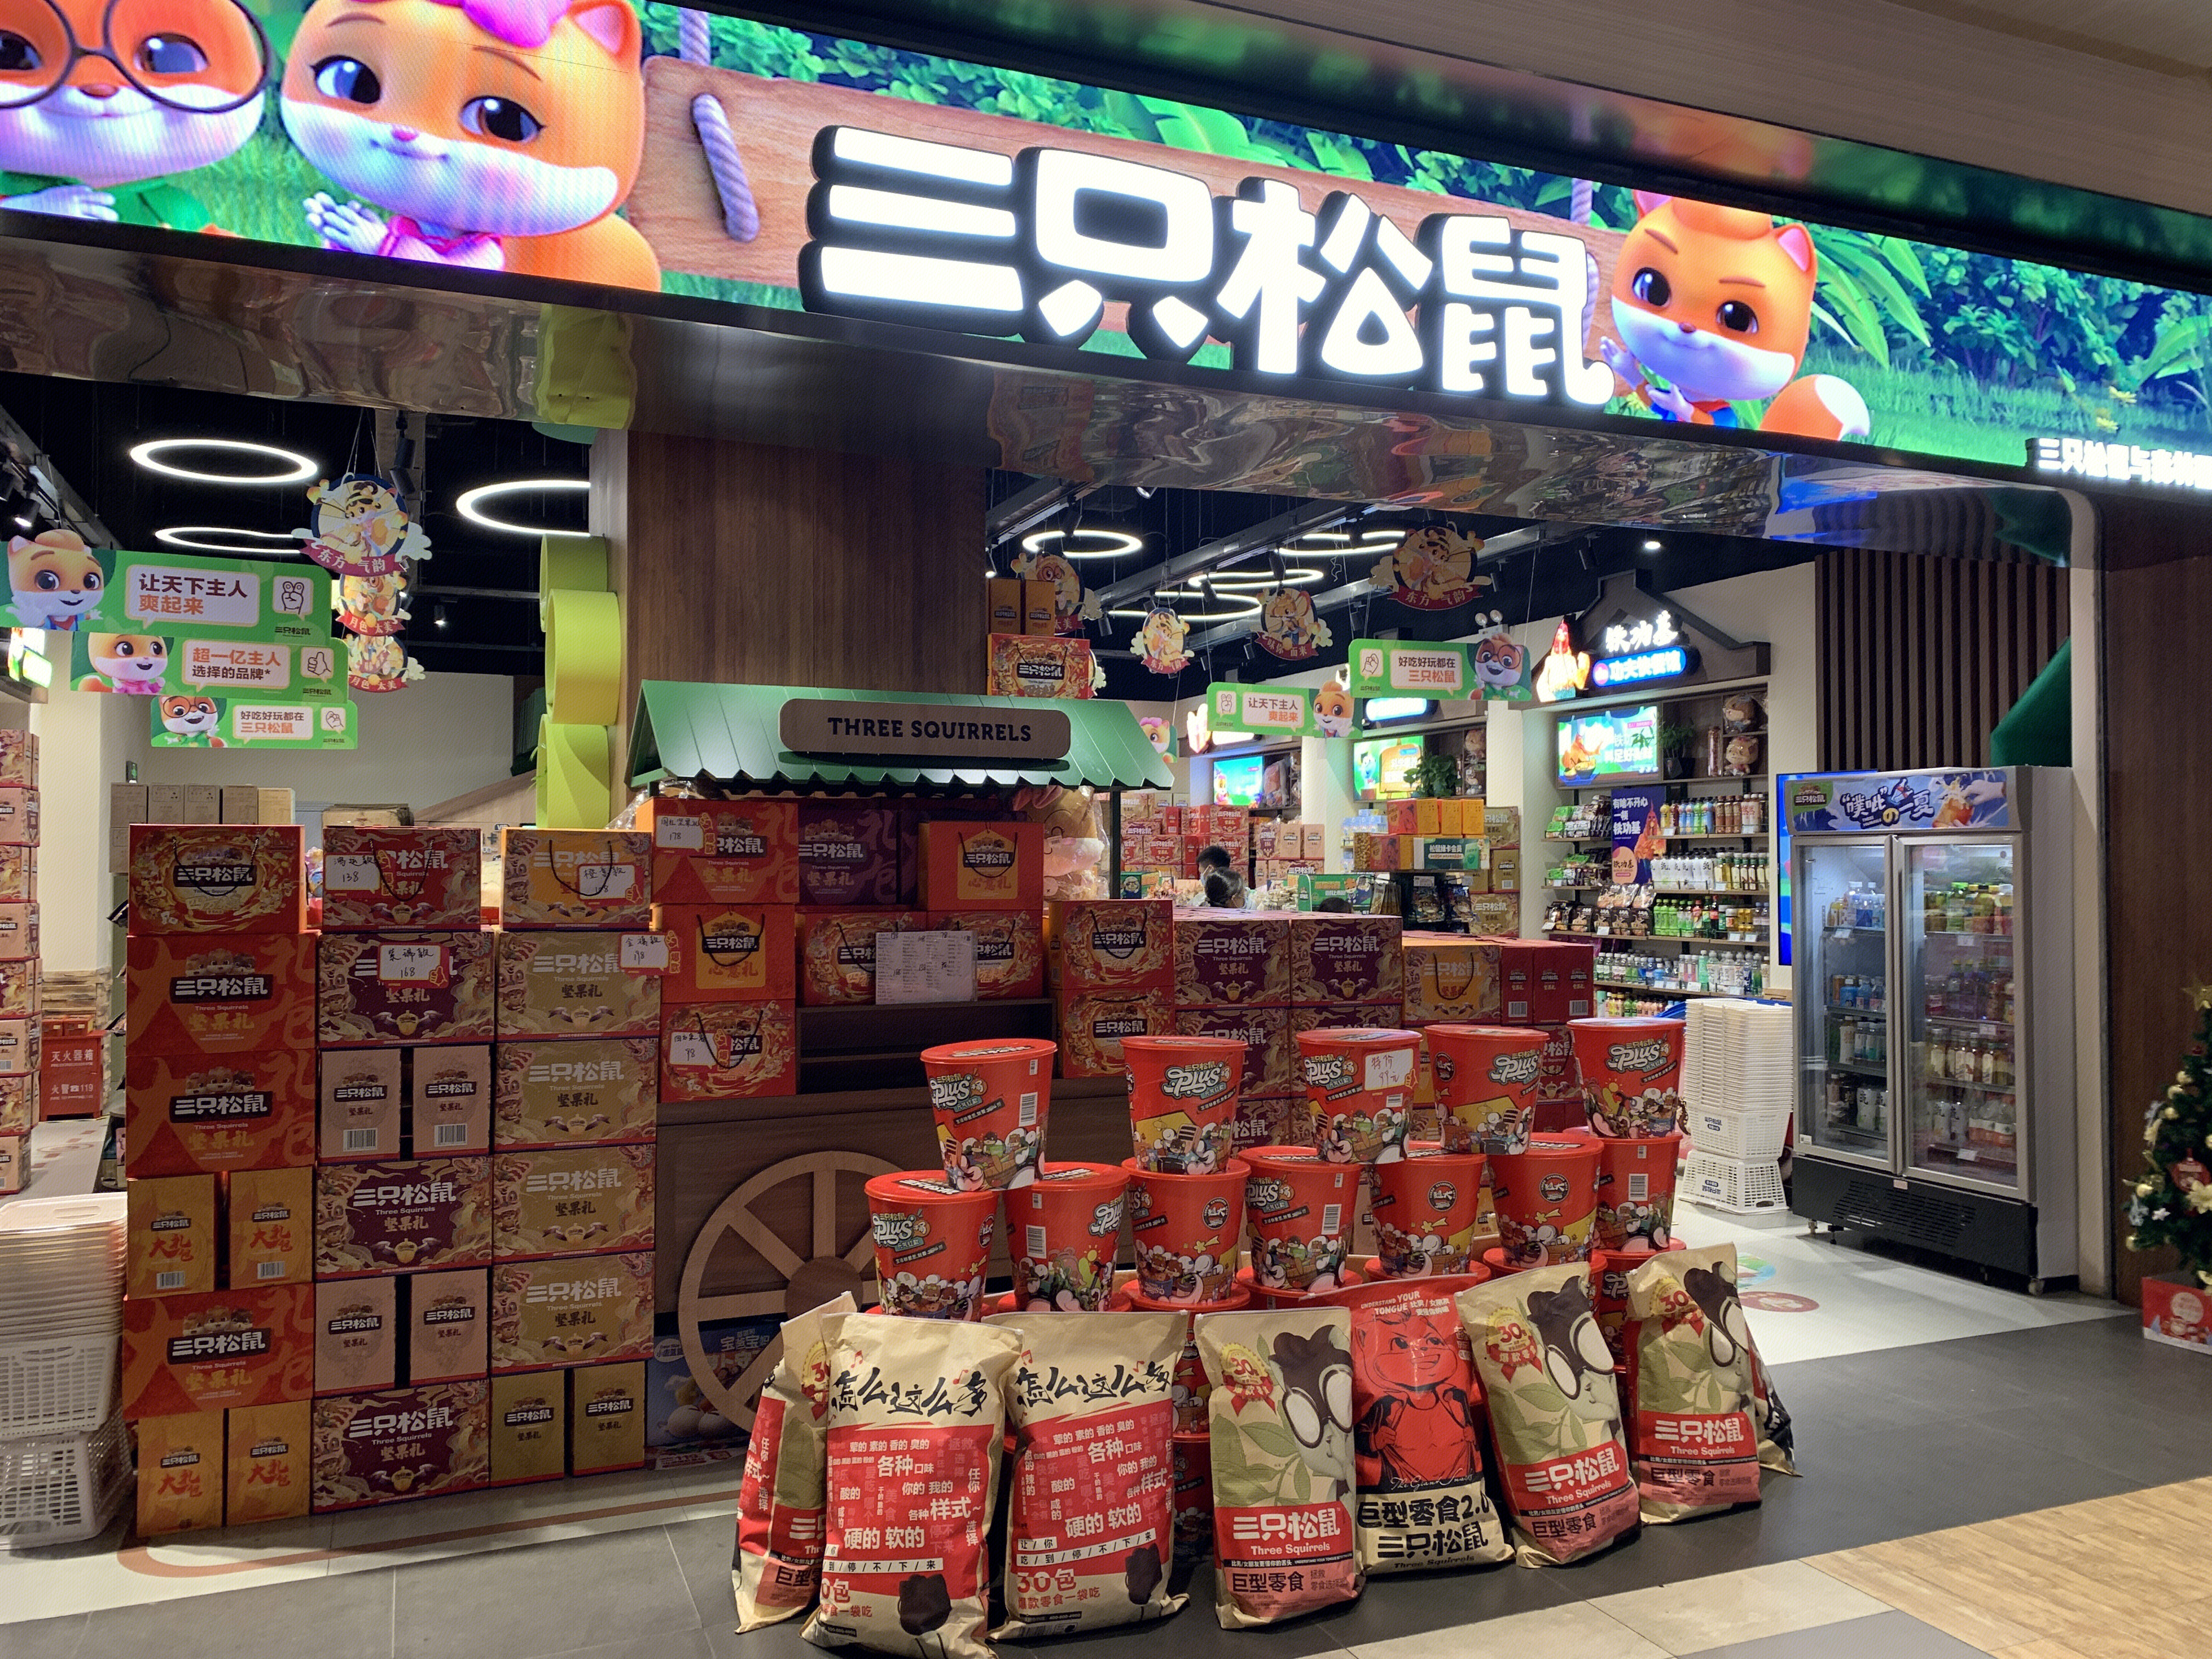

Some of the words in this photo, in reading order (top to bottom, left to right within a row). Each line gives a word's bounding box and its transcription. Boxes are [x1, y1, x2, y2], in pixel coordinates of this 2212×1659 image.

[820, 123, 1616, 405] 三只松鼠
[317, 549, 346, 569] 东方
[139, 573, 248, 599] 让天下主人
[139, 594, 204, 616] 爽起来
[1405, 591, 1431, 607] 东方
[374, 620, 394, 633] 太美
[193, 647, 281, 667] 超一亿主人
[1398, 656, 1456, 669] 好吃好玩都在
[1408, 669, 1457, 684] 三只松鼠
[1248, 697, 1299, 711] 让天下主人
[240, 710, 305, 722] 好吃好玩都在
[1268, 711, 1299, 723] 爽起来
[240, 721, 295, 735] 三只松鼠
[827, 716, 904, 738] THREE
[910, 719, 1032, 742] SQUIRRELS
[1613, 797, 1649, 809] 有啥不开心
[669, 832, 681, 840] 178
[1613, 822, 1641, 836] 铁功基
[798, 843, 864, 859] 三只松鼠
[964, 852, 1011, 865] 三只松鼠
[177, 866, 253, 883] 三只松鼠
[342, 871, 359, 883] 138
[704, 935, 757, 950] 三只松鼠
[1198, 936, 1267, 955] 三只松鼠
[1314, 935, 1380, 953] 三只松鼠
[634, 950, 645, 966] 198
[400, 967, 416, 979] 168
[174, 976, 269, 997] 三只松鼠
[561, 984, 603, 999] 坚果礼
[1095, 1020, 1145, 1034] 三只松鼠
[50, 1048, 94, 1062] 灭火器箱
[685, 1048, 696, 1062] 98
[1372, 1054, 1394, 1070] 特价
[528, 1060, 625, 1083] 三只松鼠
[80, 1083, 94, 1093] 119
[336, 1087, 385, 1099] 三只松鼠
[427, 1082, 474, 1095] 三只松鼠
[173, 1093, 268, 1115] 三只松鼠
[557, 1092, 599, 1108] 坚果礼
[526, 1167, 622, 1193] 三只松鼠
[353, 1181, 457, 1207] 三只松鼠
[253, 1210, 290, 1221] 三只松鼠
[400, 1206, 436, 1215] Squirrels
[555, 1200, 597, 1217] 坚果礼
[152, 1218, 190, 1229] 三只松鼠
[526, 1277, 622, 1304] 三只松鼠
[546, 1304, 568, 1312] Three
[569, 1300, 603, 1310] Squirrels
[1361, 1299, 1396, 1310] UNDERSTAND
[1397, 1291, 1421, 1303] YOUR
[1660, 1290, 1689, 1313] 30
[426, 1308, 473, 1322] 三只松鼠
[1374, 1303, 1408, 1316] TONGUE
[330, 1317, 380, 1331] 三只松鼠
[555, 1311, 597, 1328] 坚果礼
[172, 1331, 266, 1357] 三只松鼠
[832, 1367, 989, 1417] 怎么这么多
[1014, 1361, 1172, 1408] 怎么这么多
[587, 1400, 632, 1414] 三只松鼠
[348, 1407, 454, 1438] 三只松鼠
[506, 1409, 552, 1423] 三只松鼠
[1052, 1432, 1073, 1446] 荤的
[1075, 1427, 1094, 1442] 素的
[1096, 1423, 1115, 1437] 香的
[1116, 1419, 1135, 1434] 臭的
[1654, 1417, 1745, 1444] 三只松鼠
[371, 1438, 395, 1446] Three
[396, 1432, 432, 1444] Squirrels
[849, 1441, 867, 1453] 荤的
[869, 1440, 888, 1452] 素的
[889, 1440, 908, 1452] 香的
[910, 1438, 930, 1451] 臭的
[251, 1445, 287, 1457] 三只松鼠
[1087, 1436, 1124, 1464] 各种
[1125, 1441, 1143, 1455] 口味
[1670, 1445, 1700, 1456] Three
[1700, 1446, 1736, 1457] Squirrels
[162, 1454, 199, 1467] 三只松鼠
[877, 1454, 913, 1478] 各种
[914, 1463, 934, 1475] 口味
[1116, 1460, 1138, 1477] 你的
[1139, 1454, 1158, 1471] 我的
[1524, 1447, 1621, 1493] 三只松鼠
[1650, 1467, 1715, 1487] 巨型零食
[901, 1482, 926, 1496] 你的
[928, 1480, 953, 1494] 我的
[967, 1468, 981, 1494] 任你
[1050, 1477, 1075, 1494] 酸的
[839, 1486, 861, 1501] 酸的
[1545, 1492, 1575, 1506] Three
[1575, 1480, 1612, 1500] Squirrels
[1050, 1498, 1062, 1521] 咸的
[1064, 1511, 1104, 1539] 硬的
[1107, 1502, 1142, 1530] 软的
[1233, 1507, 1341, 1542] 三只松鼠
[1531, 1512, 1597, 1539] 巨型零食
[844, 1527, 881, 1550] 硬的
[885, 1526, 925, 1550] 软的
[1377, 1520, 1489, 1559] 三只松鼠
[1250, 1544, 1284, 1557] Three
[1285, 1541, 1331, 1556] Squirrels
[1017, 1567, 1077, 1594] 30包
[1232, 1570, 1305, 1593] 巨型零食
[1017, 1587, 1101, 1611] 爆款零食一袋吃
